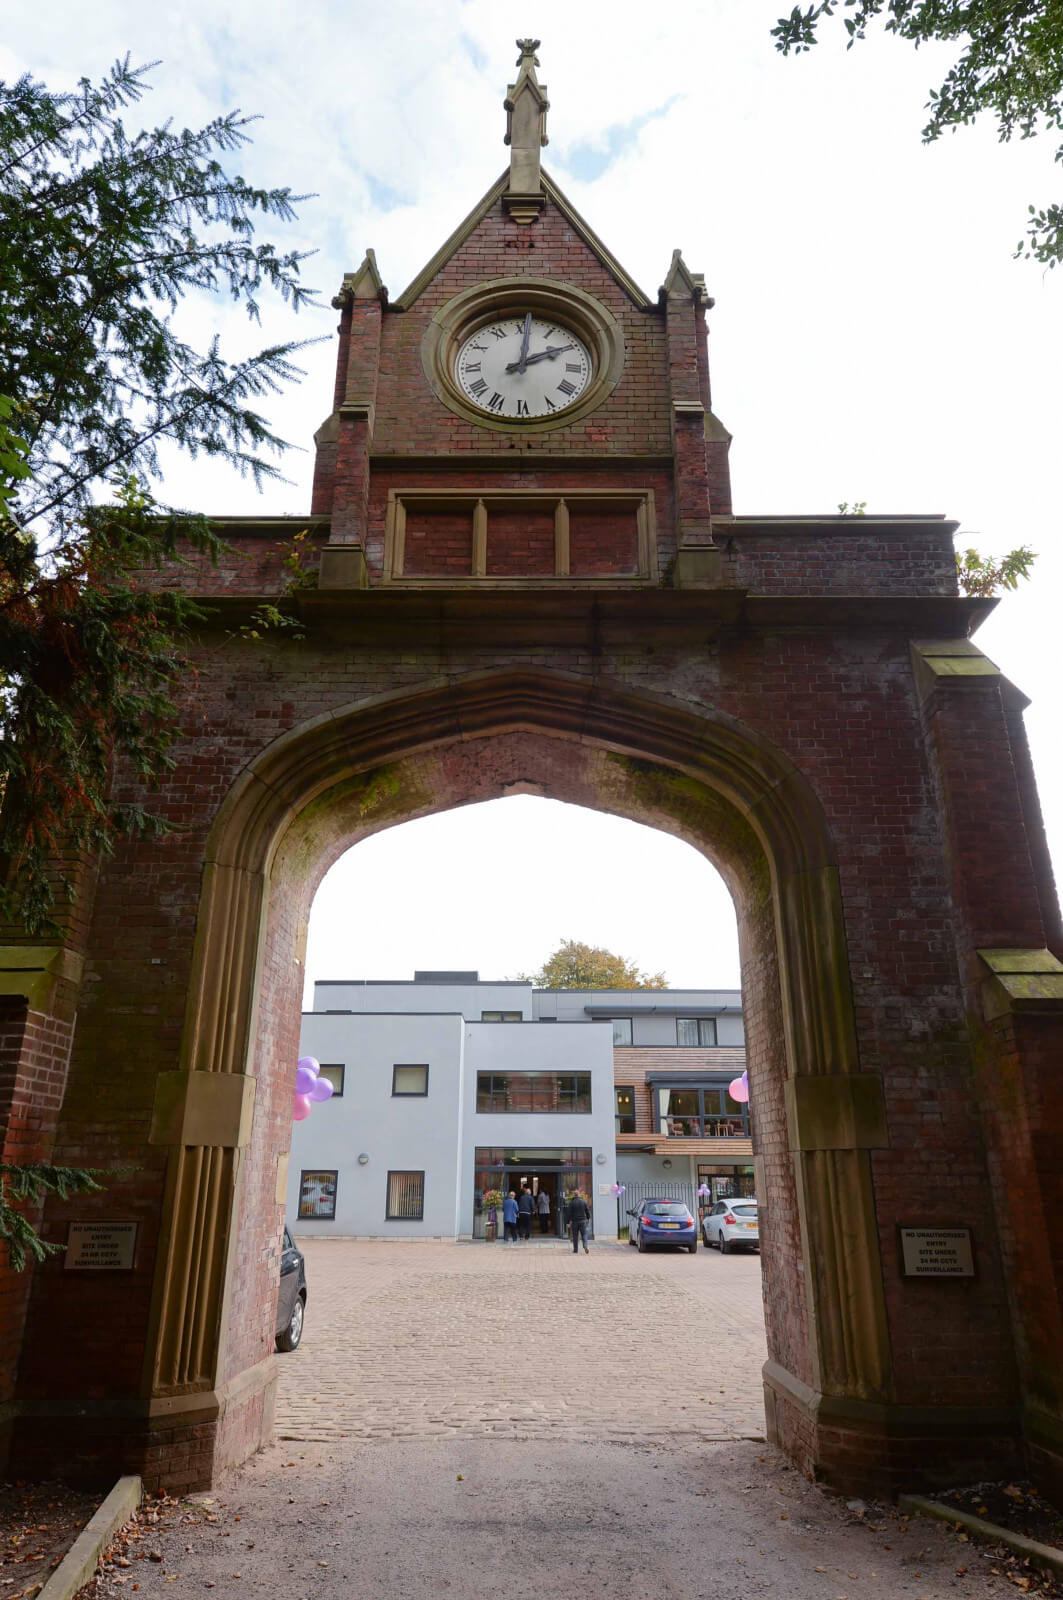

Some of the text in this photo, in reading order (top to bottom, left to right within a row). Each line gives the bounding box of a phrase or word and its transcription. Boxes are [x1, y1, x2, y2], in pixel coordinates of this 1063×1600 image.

[490, 328, 506, 341] XI
[544, 329, 555, 339] I
[472, 343, 488, 352] X
[465, 361, 481, 373] IX
[565, 362, 582, 374] III
[469, 378, 489, 398] VIII
[487, 392, 505, 411] VII
[517, 400, 530, 415] VI
[544, 395, 556, 410] V
